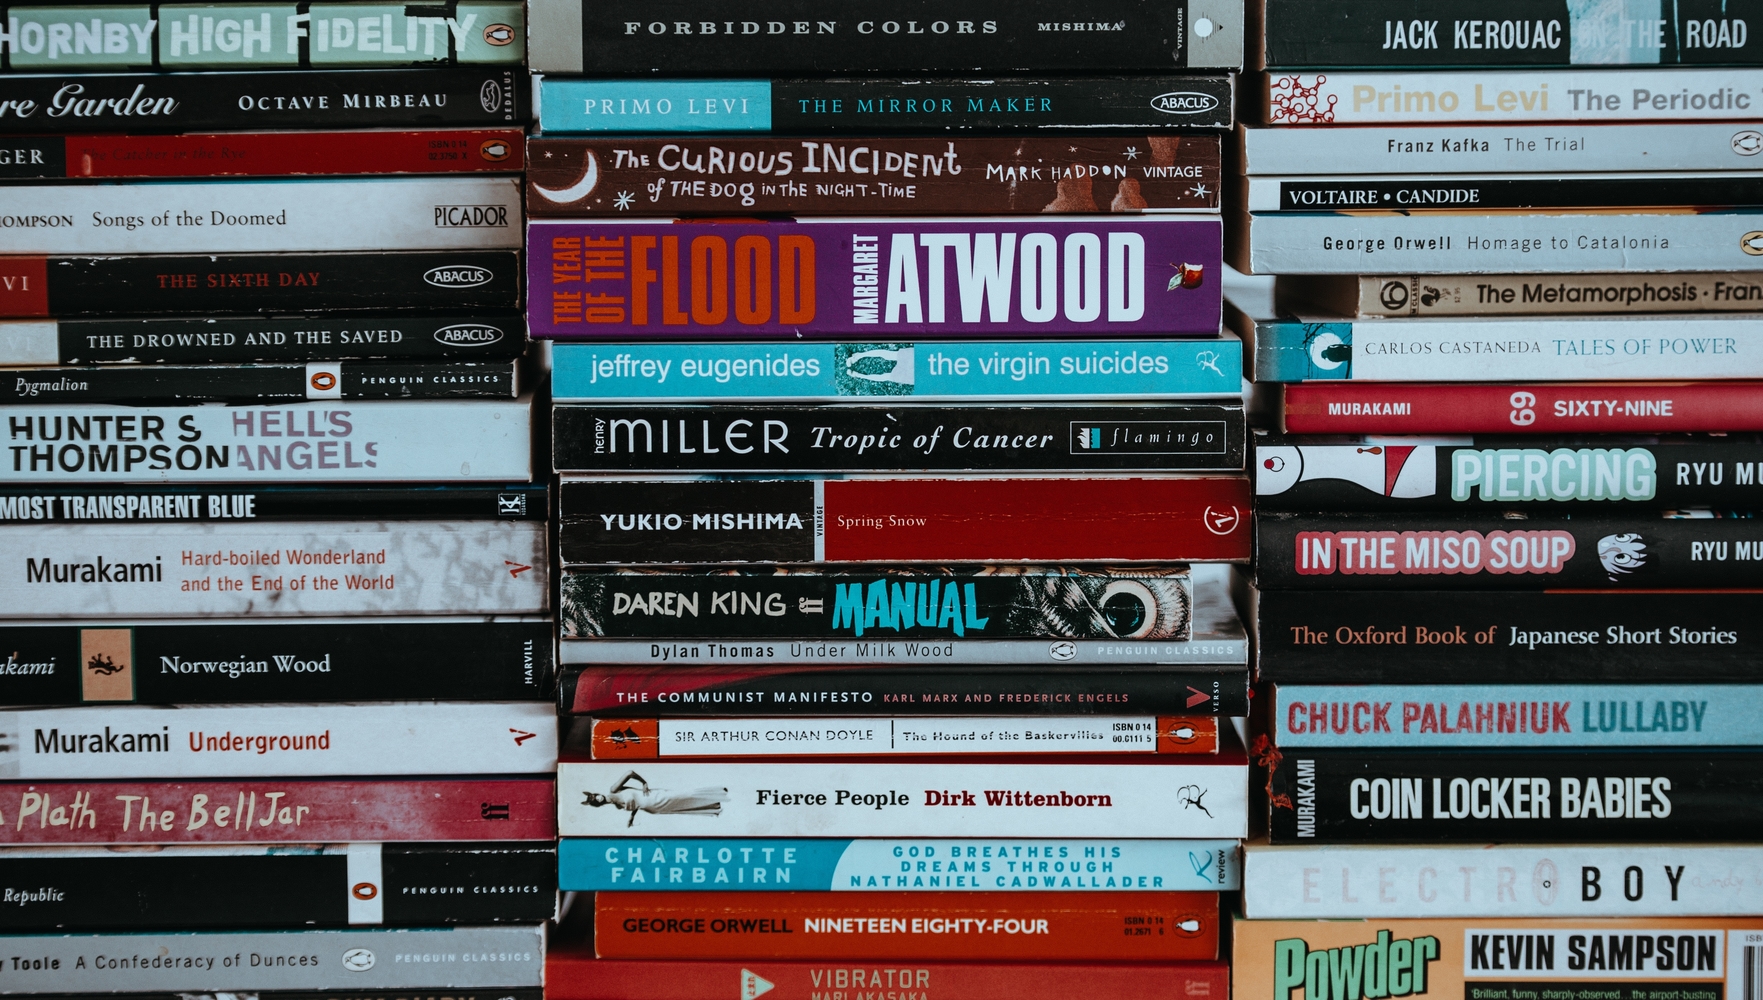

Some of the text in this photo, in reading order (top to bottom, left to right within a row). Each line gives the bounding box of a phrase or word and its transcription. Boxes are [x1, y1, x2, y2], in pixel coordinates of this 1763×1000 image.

[170, 13, 478, 57] HIGH FIDELITY
[624, 21, 998, 35] FORBIDDEN COLORS
[1038, 22, 1122, 31] MISHIMA
[1382, 20, 1561, 50] JACK KEROUAC
[1621, 19, 1747, 48] THE ROAD
[47, 81, 180, 117] Garden
[239, 93, 447, 111] OCTAVE MIRBEAU
[504, 71, 512, 120] DEDALUS
[1161, 97, 1209, 109] ABACUS
[1352, 83, 1548, 113] Primo Levi
[1568, 88, 1750, 111] The Periodic
[584, 98, 749, 114] PRIMO LEVI
[799, 98, 1052, 113] THE MIRROR MAKER
[1388, 139, 1489, 153] Franz Kafka
[1504, 137, 1585, 152] The Trial
[1143, 167, 1202, 178] VINTAGE
[1289, 189, 1479, 205] VOLTAIRE CANDIDE
[92, 209, 287, 230] Songs of the Doomed
[435, 207, 508, 226] PICADOR
[1323, 236, 1451, 253] George Orwell
[157, 272, 320, 288] THE SIXTH DAY
[434, 270, 483, 283] ABACUS
[631, 235, 816, 325] FLOOD
[853, 234, 878, 324] MARGARET
[885, 232, 1145, 323] ATWOOD
[1477, 282, 1697, 306] The Metamorphosis
[444, 328, 494, 341] ABACUS
[1365, 341, 1541, 355] CARLOS CASTANEDA
[1553, 338, 1737, 356] TALES OF POWER
[591, 354, 820, 383] jeffrey eugenides
[928, 351, 1168, 381] the virgin suicides
[15, 377, 88, 397] Pygmalion
[362, 375, 499, 384] PENGUIN CLASSICS
[1329, 402, 1410, 415] MURAKAMI
[1554, 400, 1673, 417] SIXTY-NINE
[9, 415, 164, 442] HUNTER
[233, 411, 353, 437] HELL'S
[811, 426, 1054, 455] Tropic of Cancer
[1110, 428, 1214, 447] flamingo
[9, 445, 229, 472] THOMPSON
[1457, 454, 1651, 497] PIERCING
[63, 494, 255, 519] TRANSPARENT BLUE
[600, 513, 804, 530] YUKIO MISHIMA
[837, 515, 927, 529] Spring Snow
[182, 550, 385, 567] Hard-boiled Wonderland
[1302, 537, 1569, 569] IN THE MISO SOUP
[27, 556, 162, 583] Murakami
[612, 591, 786, 618] DAREN KING
[832, 578, 989, 637] MANUAL
[1508, 626, 1737, 650] Japanese Short Stories
[651, 645, 774, 660] Dylan Thomas
[791, 643, 953, 657] Under Milk Wood
[1098, 646, 1234, 655] PENGUIN CLASSICS
[161, 655, 331, 678] Norwegian Wood
[524, 639, 533, 684] HARVILL
[617, 692, 873, 702] THE COMMUNIST MANIFESTO
[883, 694, 1128, 702] KARL MARX AND FREDERICK ENGELS
[1288, 701, 1571, 734] CHUCK PALAHNIUK
[1583, 701, 1707, 732] LULLABY
[34, 726, 169, 754] Murakami
[189, 731, 330, 754] Underground
[675, 730, 873, 742] SIR ARTHUR CONAN DOYLE
[756, 790, 910, 809] Fierce People
[925, 790, 1113, 807] Dirk Wittenborn
[1297, 759, 1315, 837] MURAKAMI
[1350, 777, 1671, 819] COIN LOCKER BABIES
[605, 848, 796, 864] CHARLOTTE
[893, 847, 1121, 858] GOD BREATHES HIS
[611, 868, 791, 883] FAIRBAIRN
[901, 861, 1113, 872] DREAMS THROUGH
[402, 886, 539, 895] PENGUIN CLASSICS
[850, 876, 1163, 887] NATHANIEL CADWALLADER
[1582, 866, 1685, 902] BOY
[4, 887, 64, 904] Republic
[623, 918, 793, 933] GEORGE ORWELL
[804, 918, 1049, 934] NINETEEN EIGHTY-FOUR
[396, 952, 531, 963] PENGUIN CLASSICS
[1472, 935, 1716, 971] KEVIN SAMPSON
[810, 969, 930, 988] VIBRATOR
